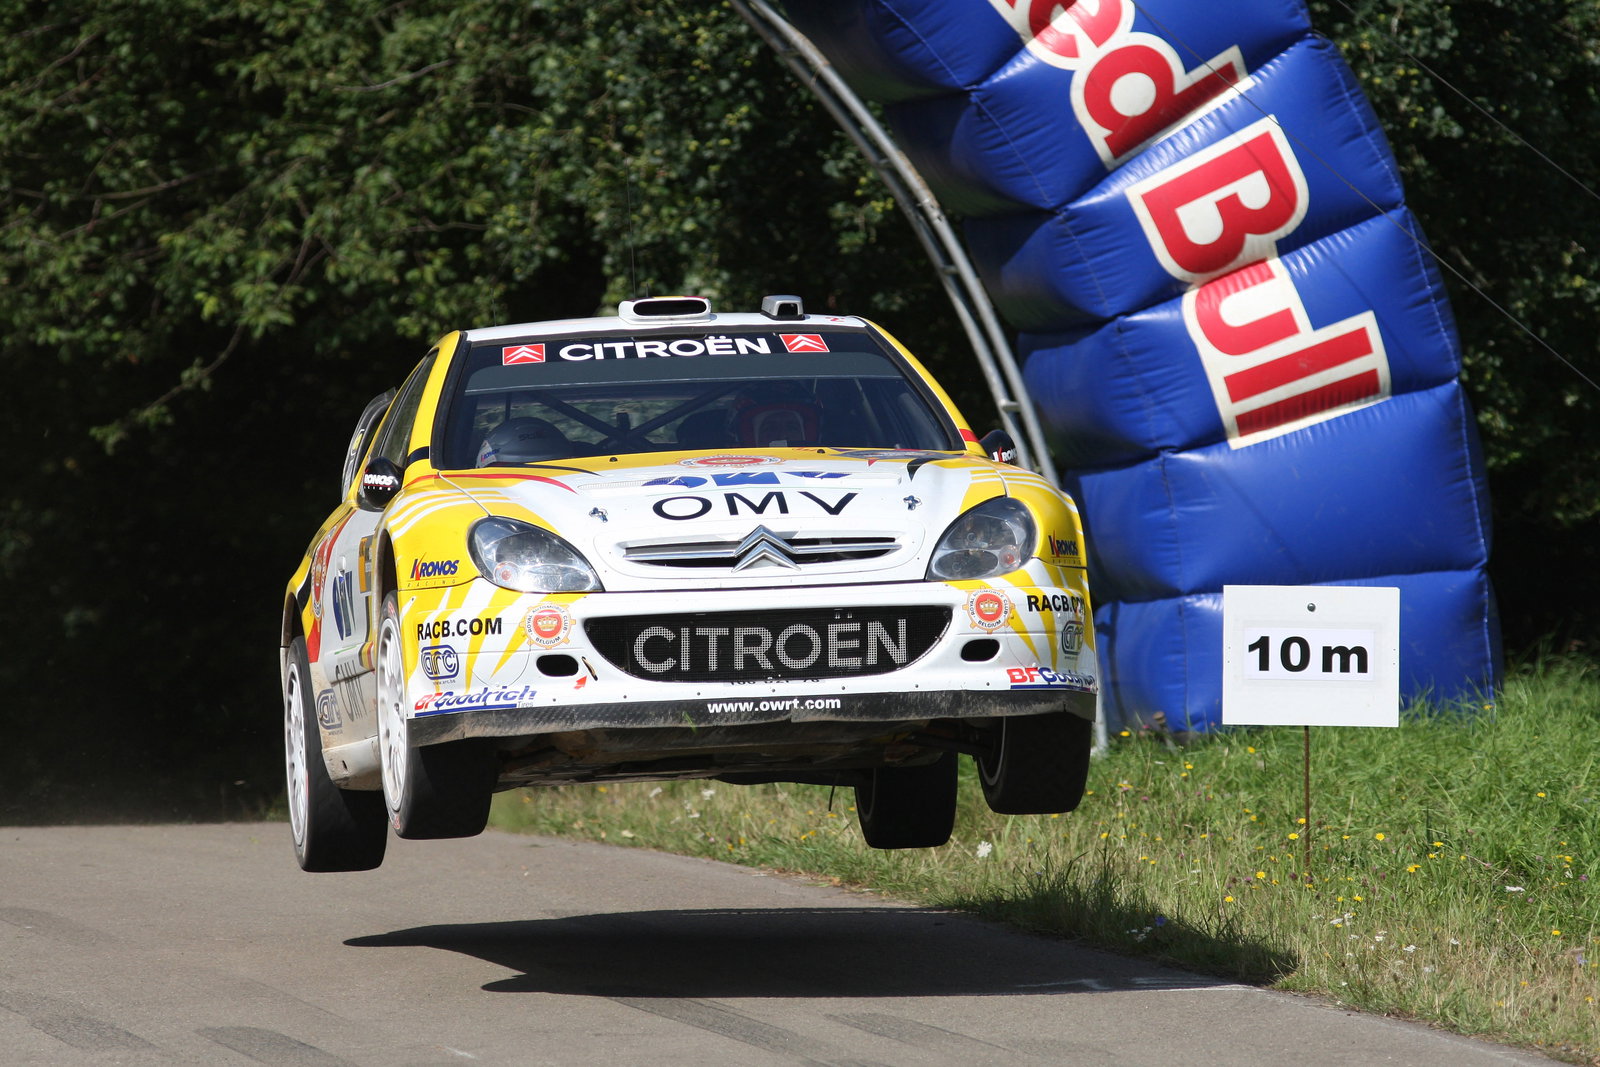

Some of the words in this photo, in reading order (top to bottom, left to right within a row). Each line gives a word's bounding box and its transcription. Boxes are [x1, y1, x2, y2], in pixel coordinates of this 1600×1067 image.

[1003, 0, 1246, 166] ed
[1136, 124, 1387, 444] Bull
[558, 335, 771, 362] CITROËN
[652, 491, 859, 521] OMV
[1048, 530, 1079, 557] KRONOS
[410, 551, 460, 581] KRONOS
[417, 617, 502, 641] RACB.COM
[977, 619, 1002, 628] BELGIUM
[535, 635, 561, 645] BELGIUM
[632, 612, 908, 675] CITROËN
[1248, 635, 1311, 673] 10
[1321, 645, 1368, 674] m
[414, 685, 538, 711] BFGoodrich
[707, 697, 842, 714] www.owrt.com
